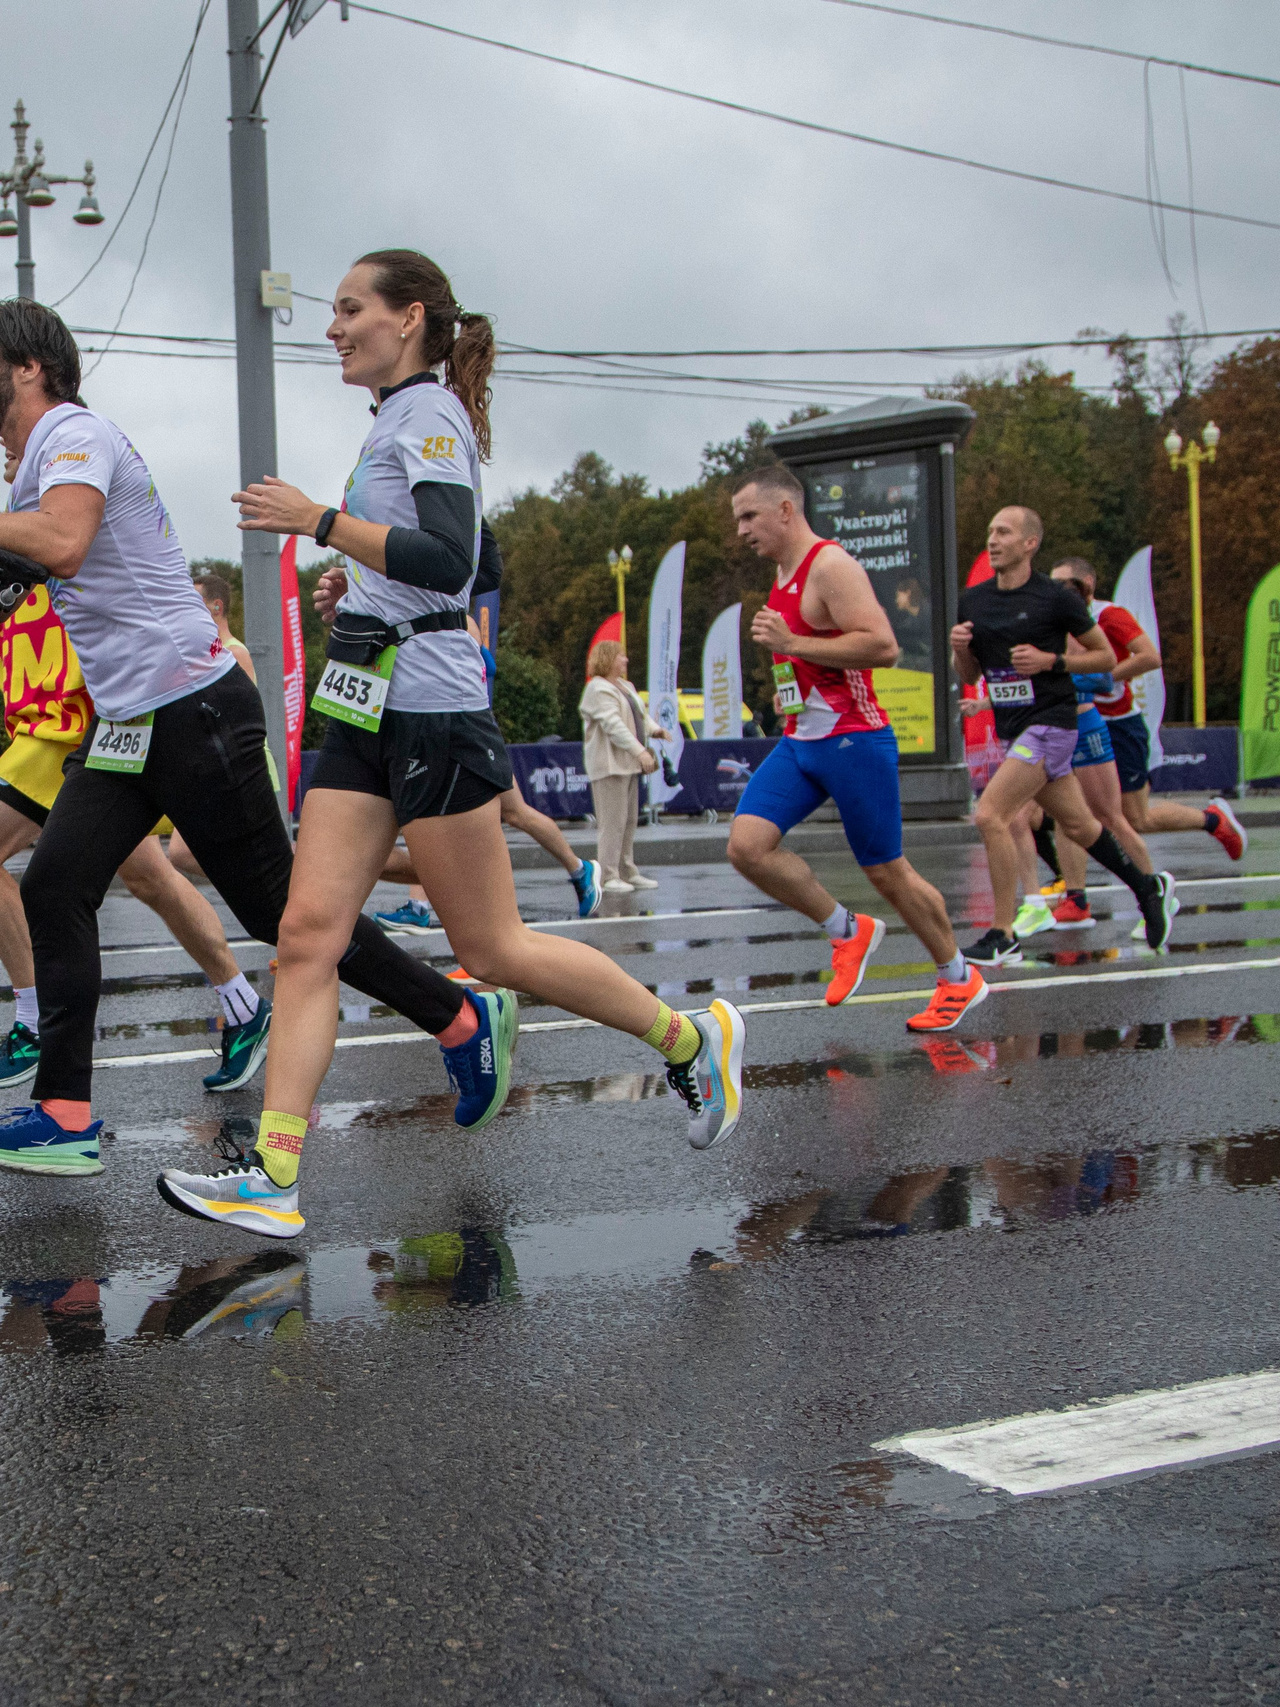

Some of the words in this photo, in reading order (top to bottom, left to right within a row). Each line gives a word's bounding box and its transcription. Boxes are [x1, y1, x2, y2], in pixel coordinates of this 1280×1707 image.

[422, 436, 456, 453] ZRT
[833, 508, 907, 532] Участвуй!
[856, 550, 910, 571] еждай!
[324, 668, 372, 705] 4453
[995, 685, 1027, 698] 5578
[97, 731, 141, 754] 4496
[1163, 753, 1207, 765] OWERUP
[480, 1036, 493, 1074] HOKA
